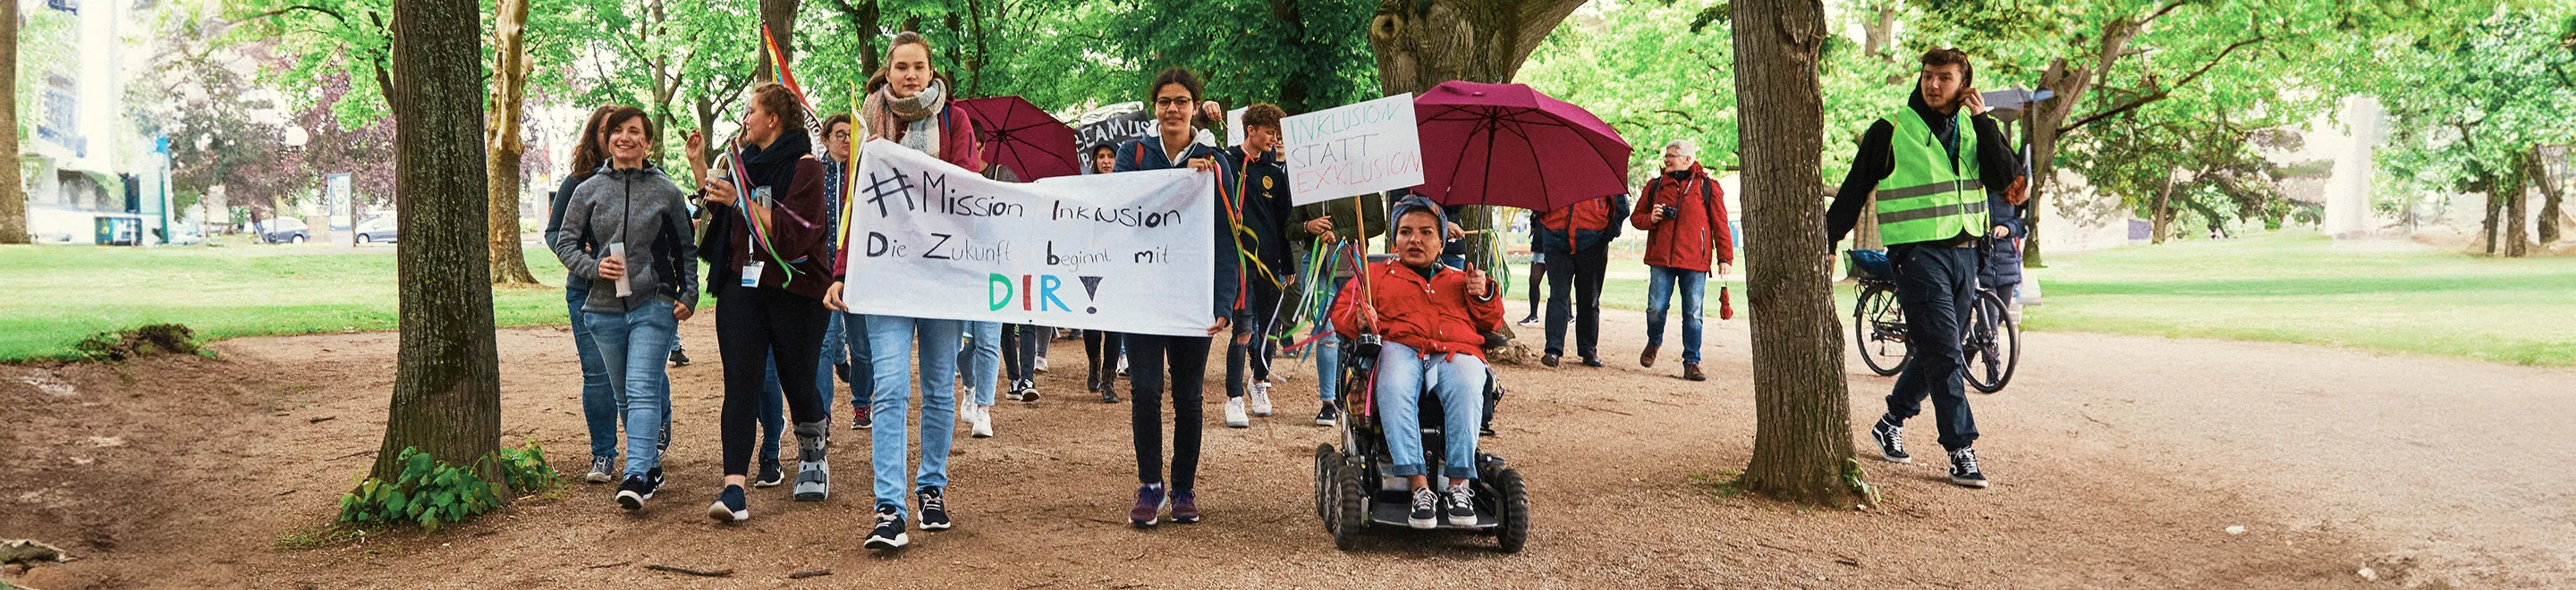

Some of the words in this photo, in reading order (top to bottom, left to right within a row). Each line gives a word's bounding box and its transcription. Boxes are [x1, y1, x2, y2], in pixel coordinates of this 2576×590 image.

[1290, 102, 1402, 145] INKLUSION
[1291, 133, 1379, 170] STATT
[1297, 150, 1421, 194] EXKLUSION
[861, 167, 1023, 218] #Mission
[866, 231, 907, 257] Die
[922, 232, 1011, 266] Zukunft
[1046, 240, 1112, 272] beginnt
[1134, 244, 1170, 264] mit
[988, 273, 1104, 315] DIR!
